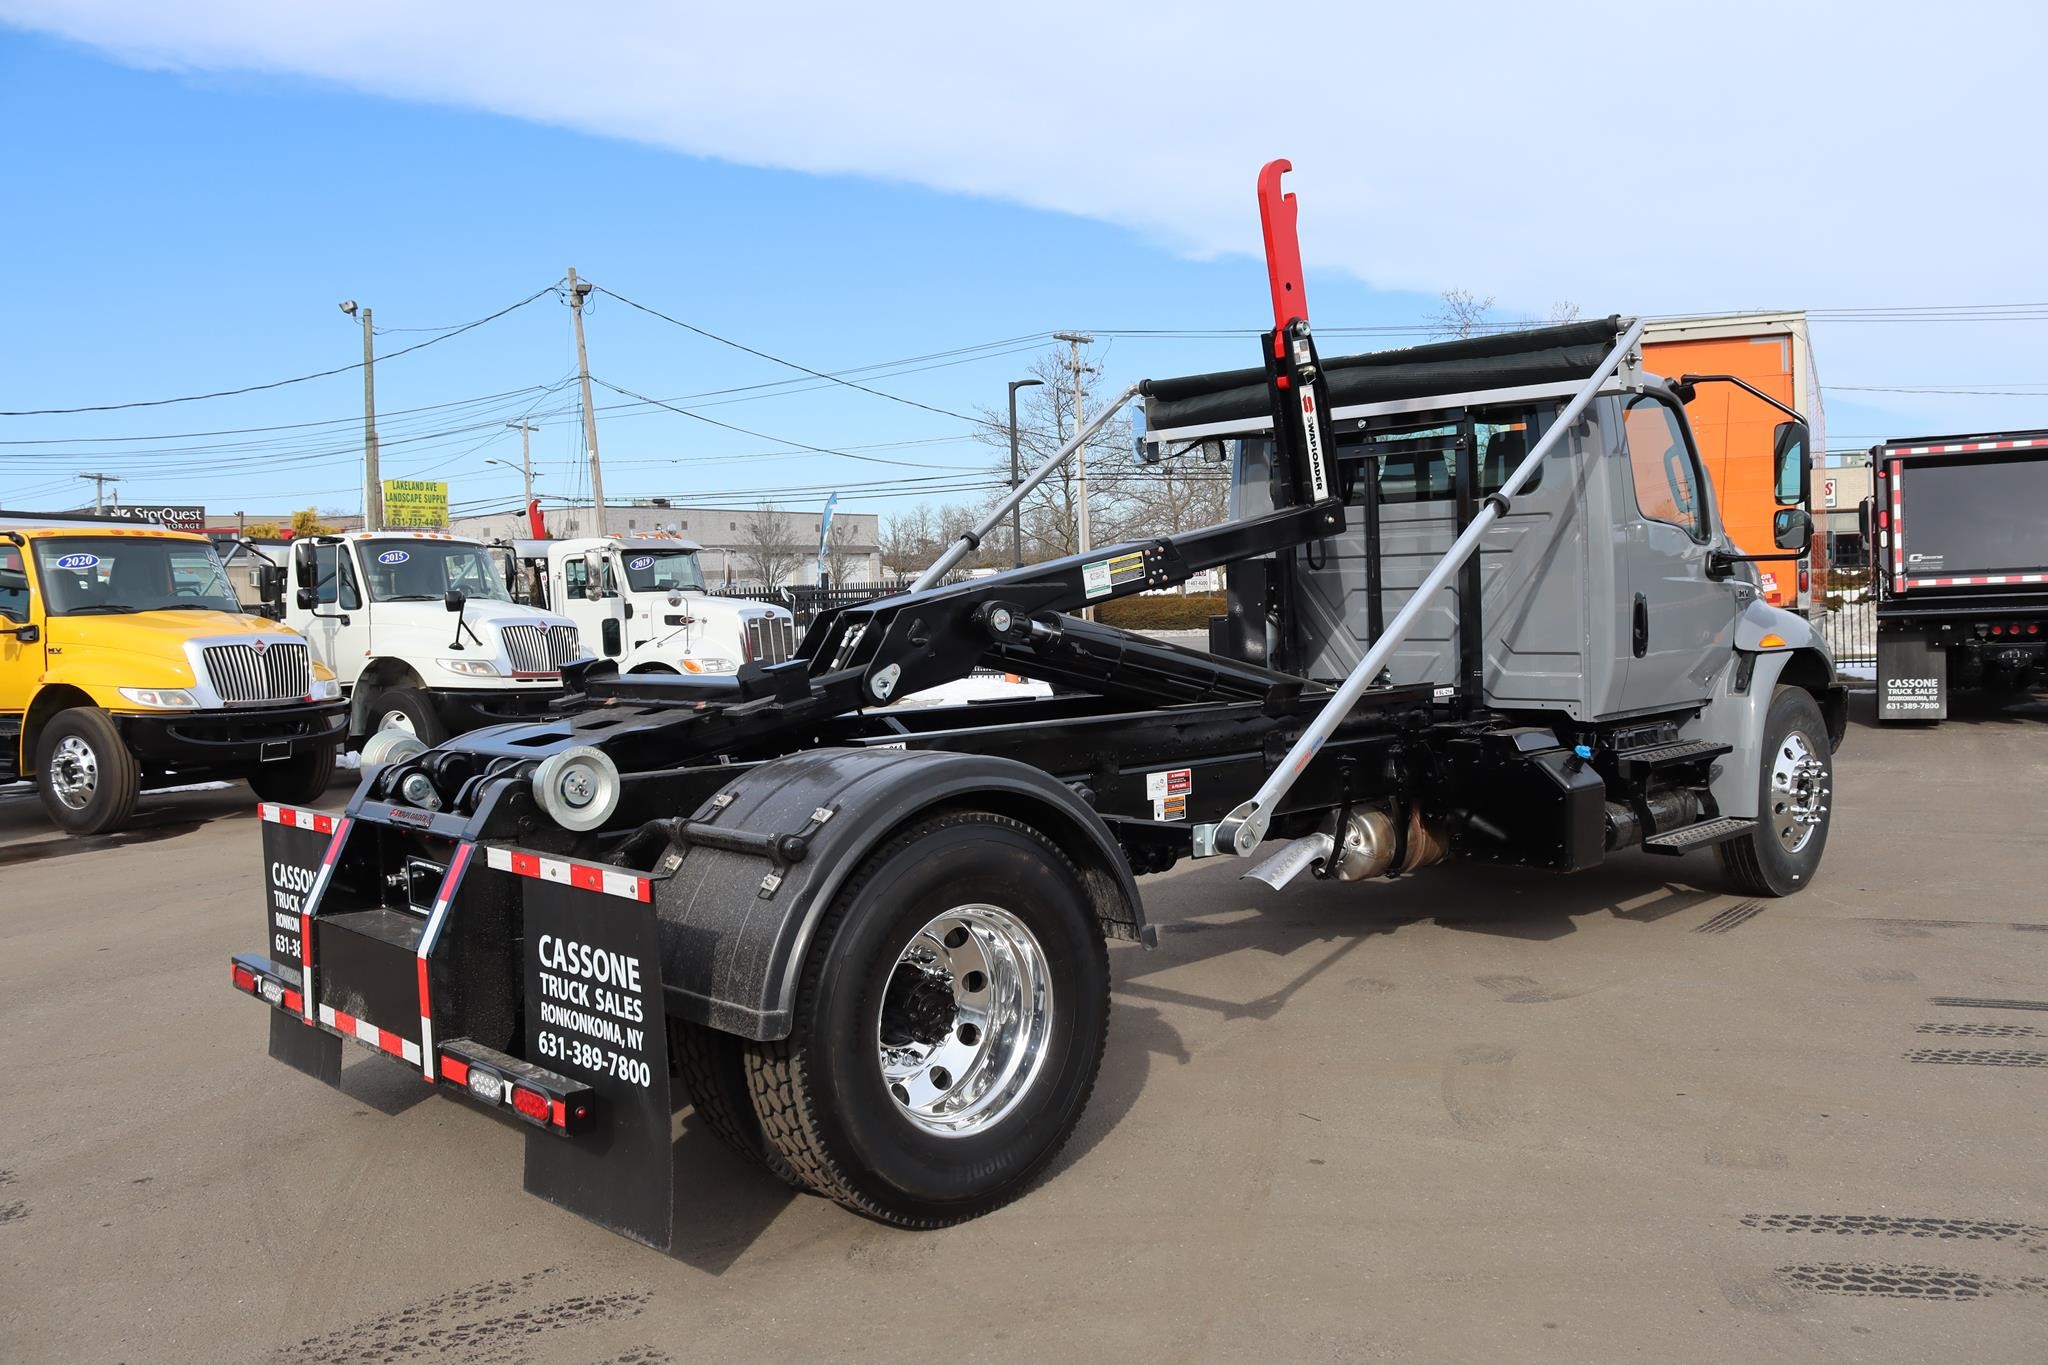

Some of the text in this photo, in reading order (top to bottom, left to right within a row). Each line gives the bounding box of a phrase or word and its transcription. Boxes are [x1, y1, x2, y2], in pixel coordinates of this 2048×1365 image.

[1307, 416, 1322, 490] SWAPLOADER
[392, 480, 437, 492] LAKELAND AVE
[385, 492, 446, 504] LANDSCAPE SUPPLY
[135, 507, 201, 523] StorQuest
[65, 556, 93, 567] 2020
[385, 552, 404, 562] 2015
[635, 557, 650, 569] 2019
[1887, 678, 1938, 688] CASSONE
[1886, 702, 1940, 710] 631-389-7800
[272, 862, 316, 894] CASSON
[273, 890, 300, 913] TRUCK
[275, 912, 300, 933] RONKON
[538, 934, 642, 993] CASSONE
[539, 971, 644, 1023] TRUCK SALES
[541, 1001, 644, 1051] RONKONKOMA, NY
[538, 1031, 651, 1088] 631-389-7800
